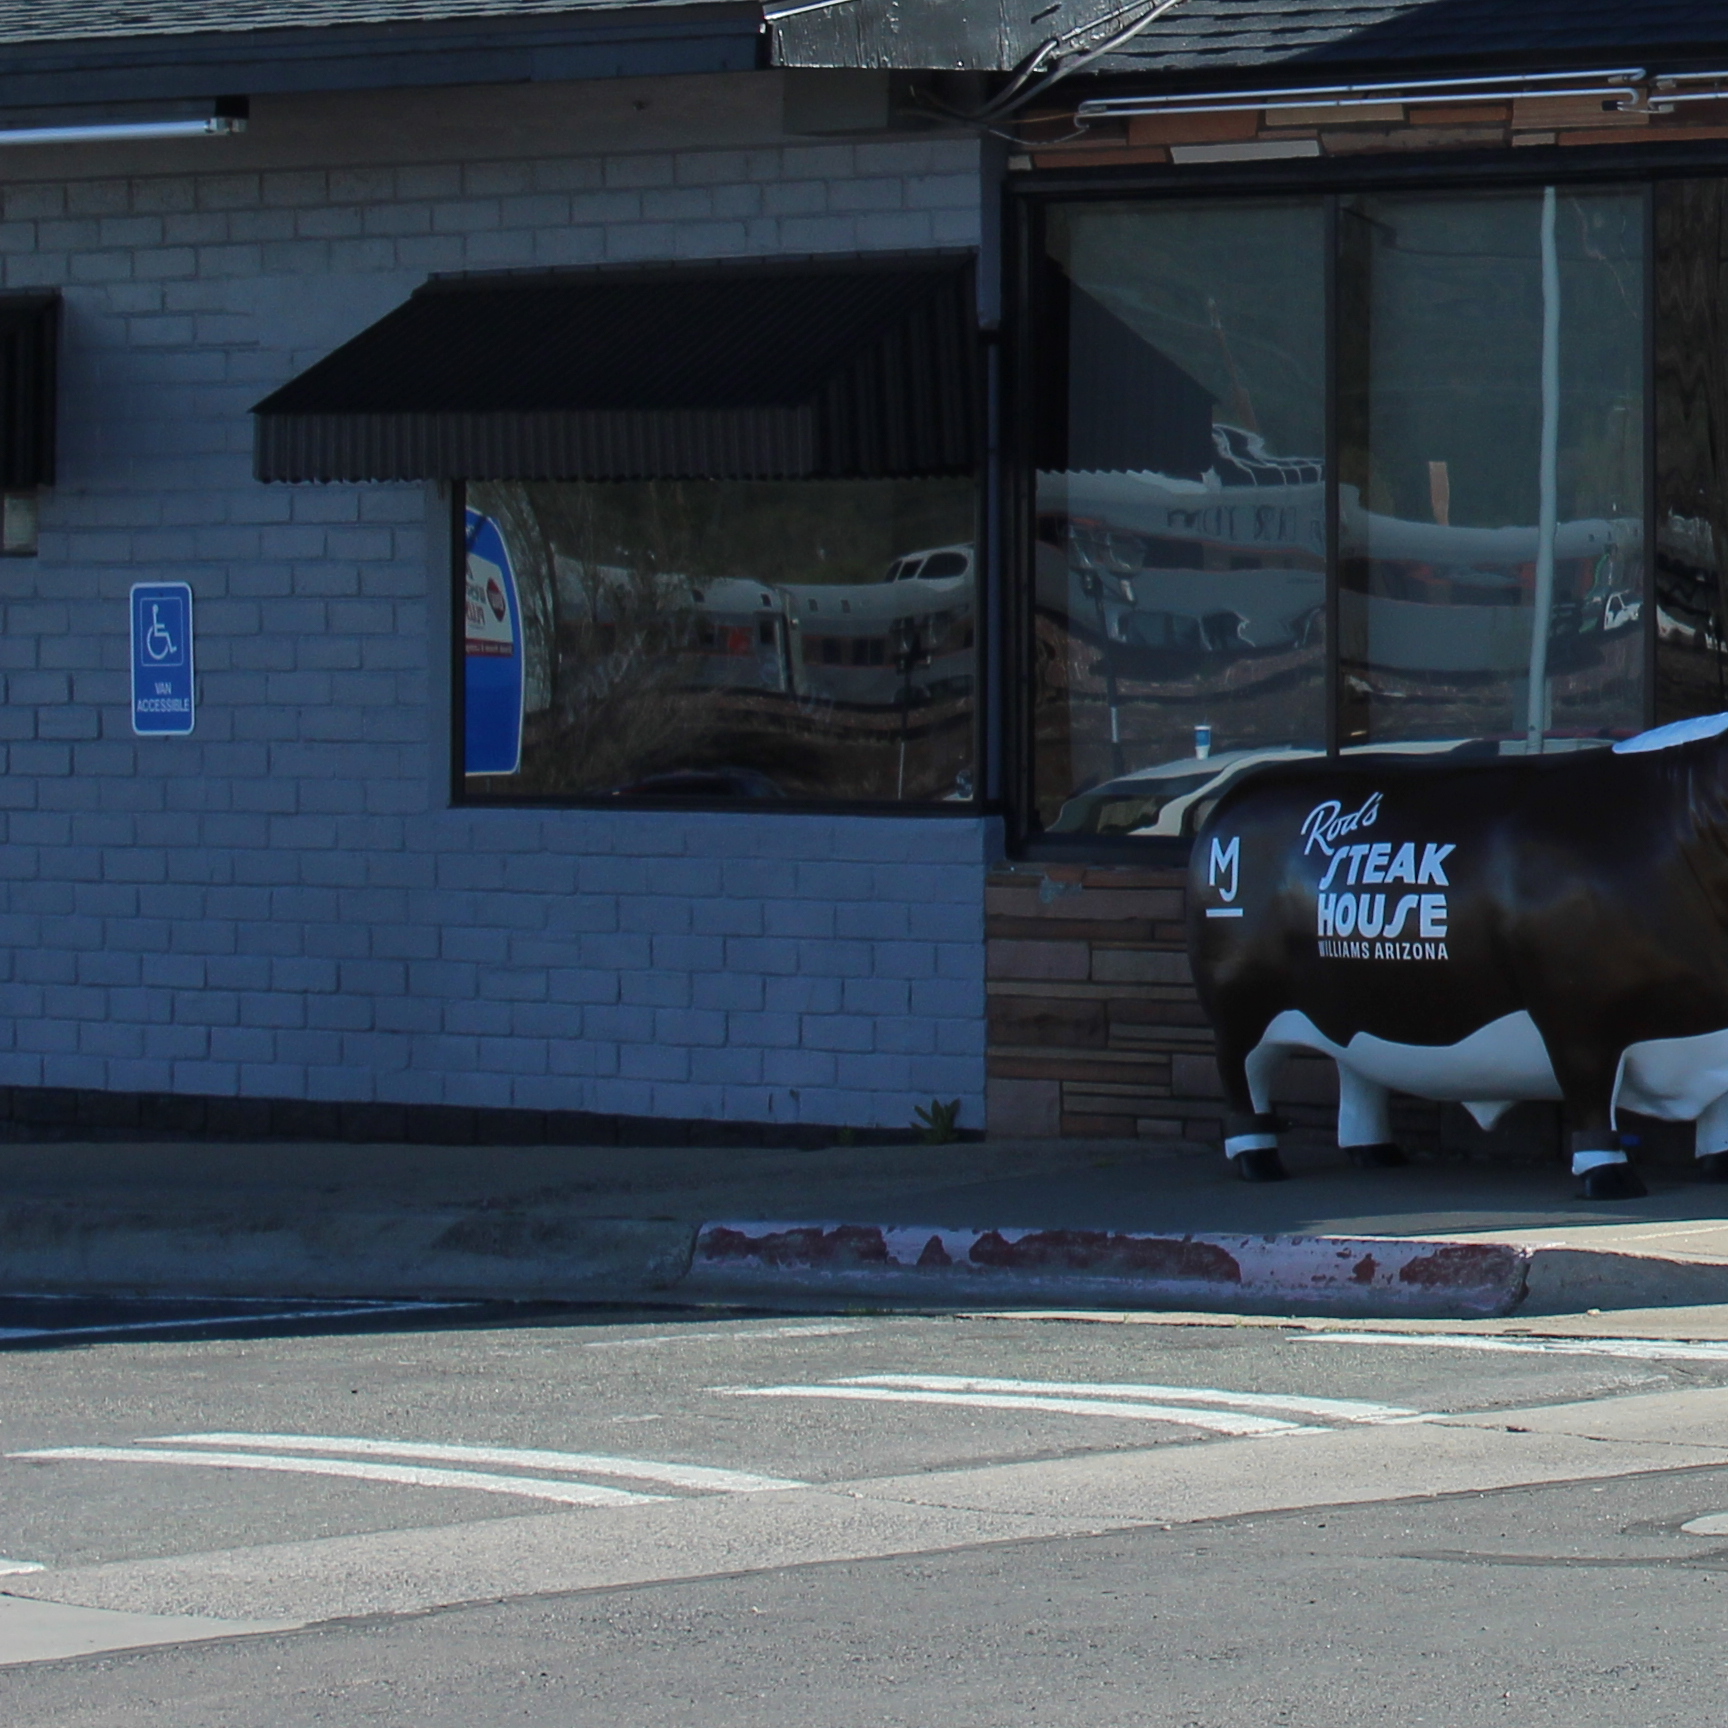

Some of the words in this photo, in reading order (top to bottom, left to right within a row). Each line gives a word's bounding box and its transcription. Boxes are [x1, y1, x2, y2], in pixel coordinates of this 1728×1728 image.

[154, 682, 171, 694] VAN
[136, 698, 189, 712] ACCESSIBLE
[1301, 790, 1384, 856] Rod's
[1318, 841, 1457, 891] STEAK
[1317, 891, 1448, 939] HOUSE
[1318, 940, 1369, 958] WILLIAMS
[1374, 941, 1448, 959] ARIZONA
